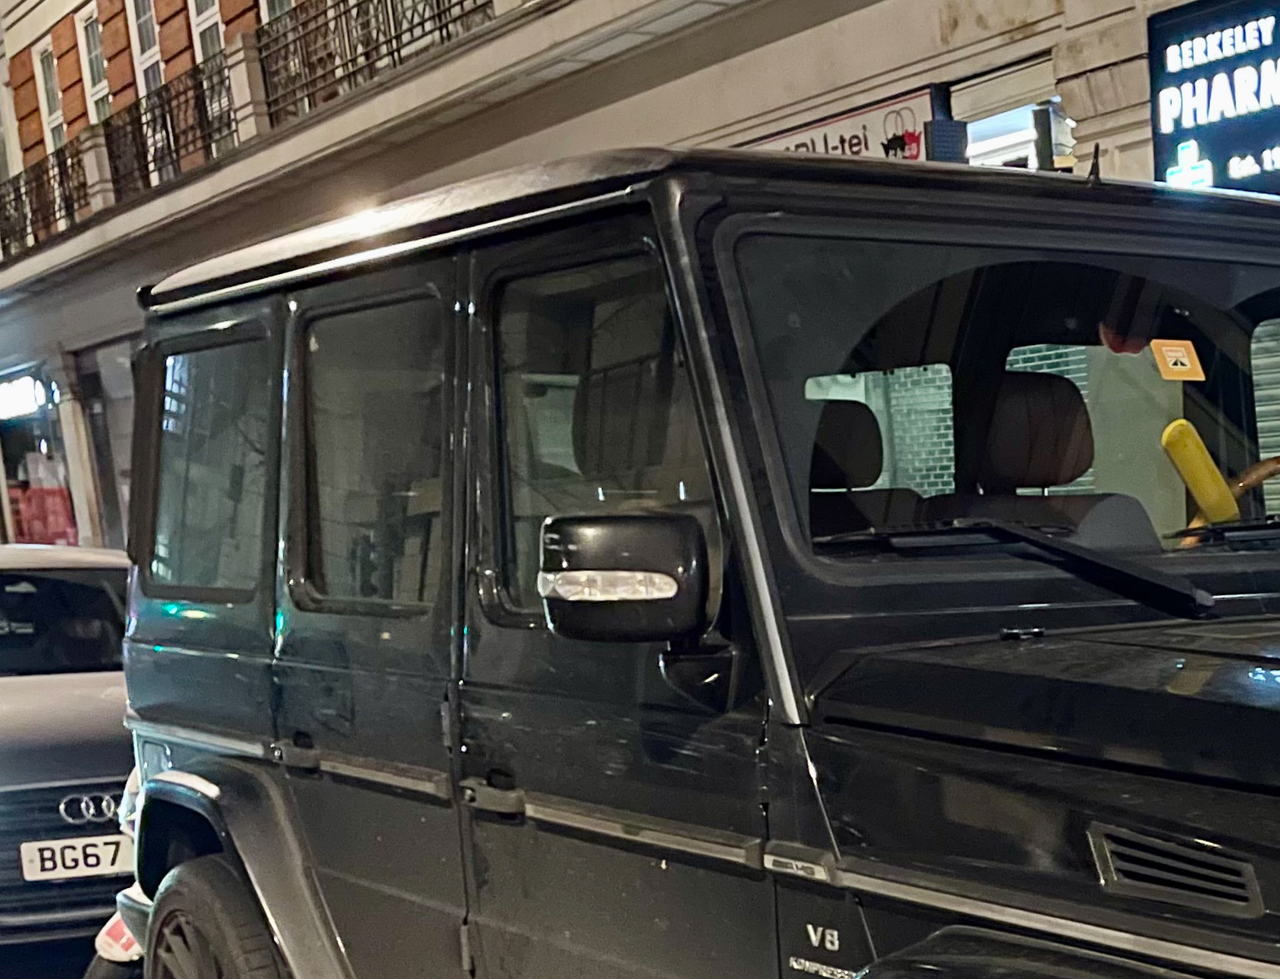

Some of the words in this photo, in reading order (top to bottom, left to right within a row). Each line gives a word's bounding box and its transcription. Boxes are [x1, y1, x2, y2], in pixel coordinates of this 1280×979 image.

[1166, 16, 1276, 73] BERKELEY
[38, 840, 122, 872] BG67
[806, 924, 839, 951] V8
